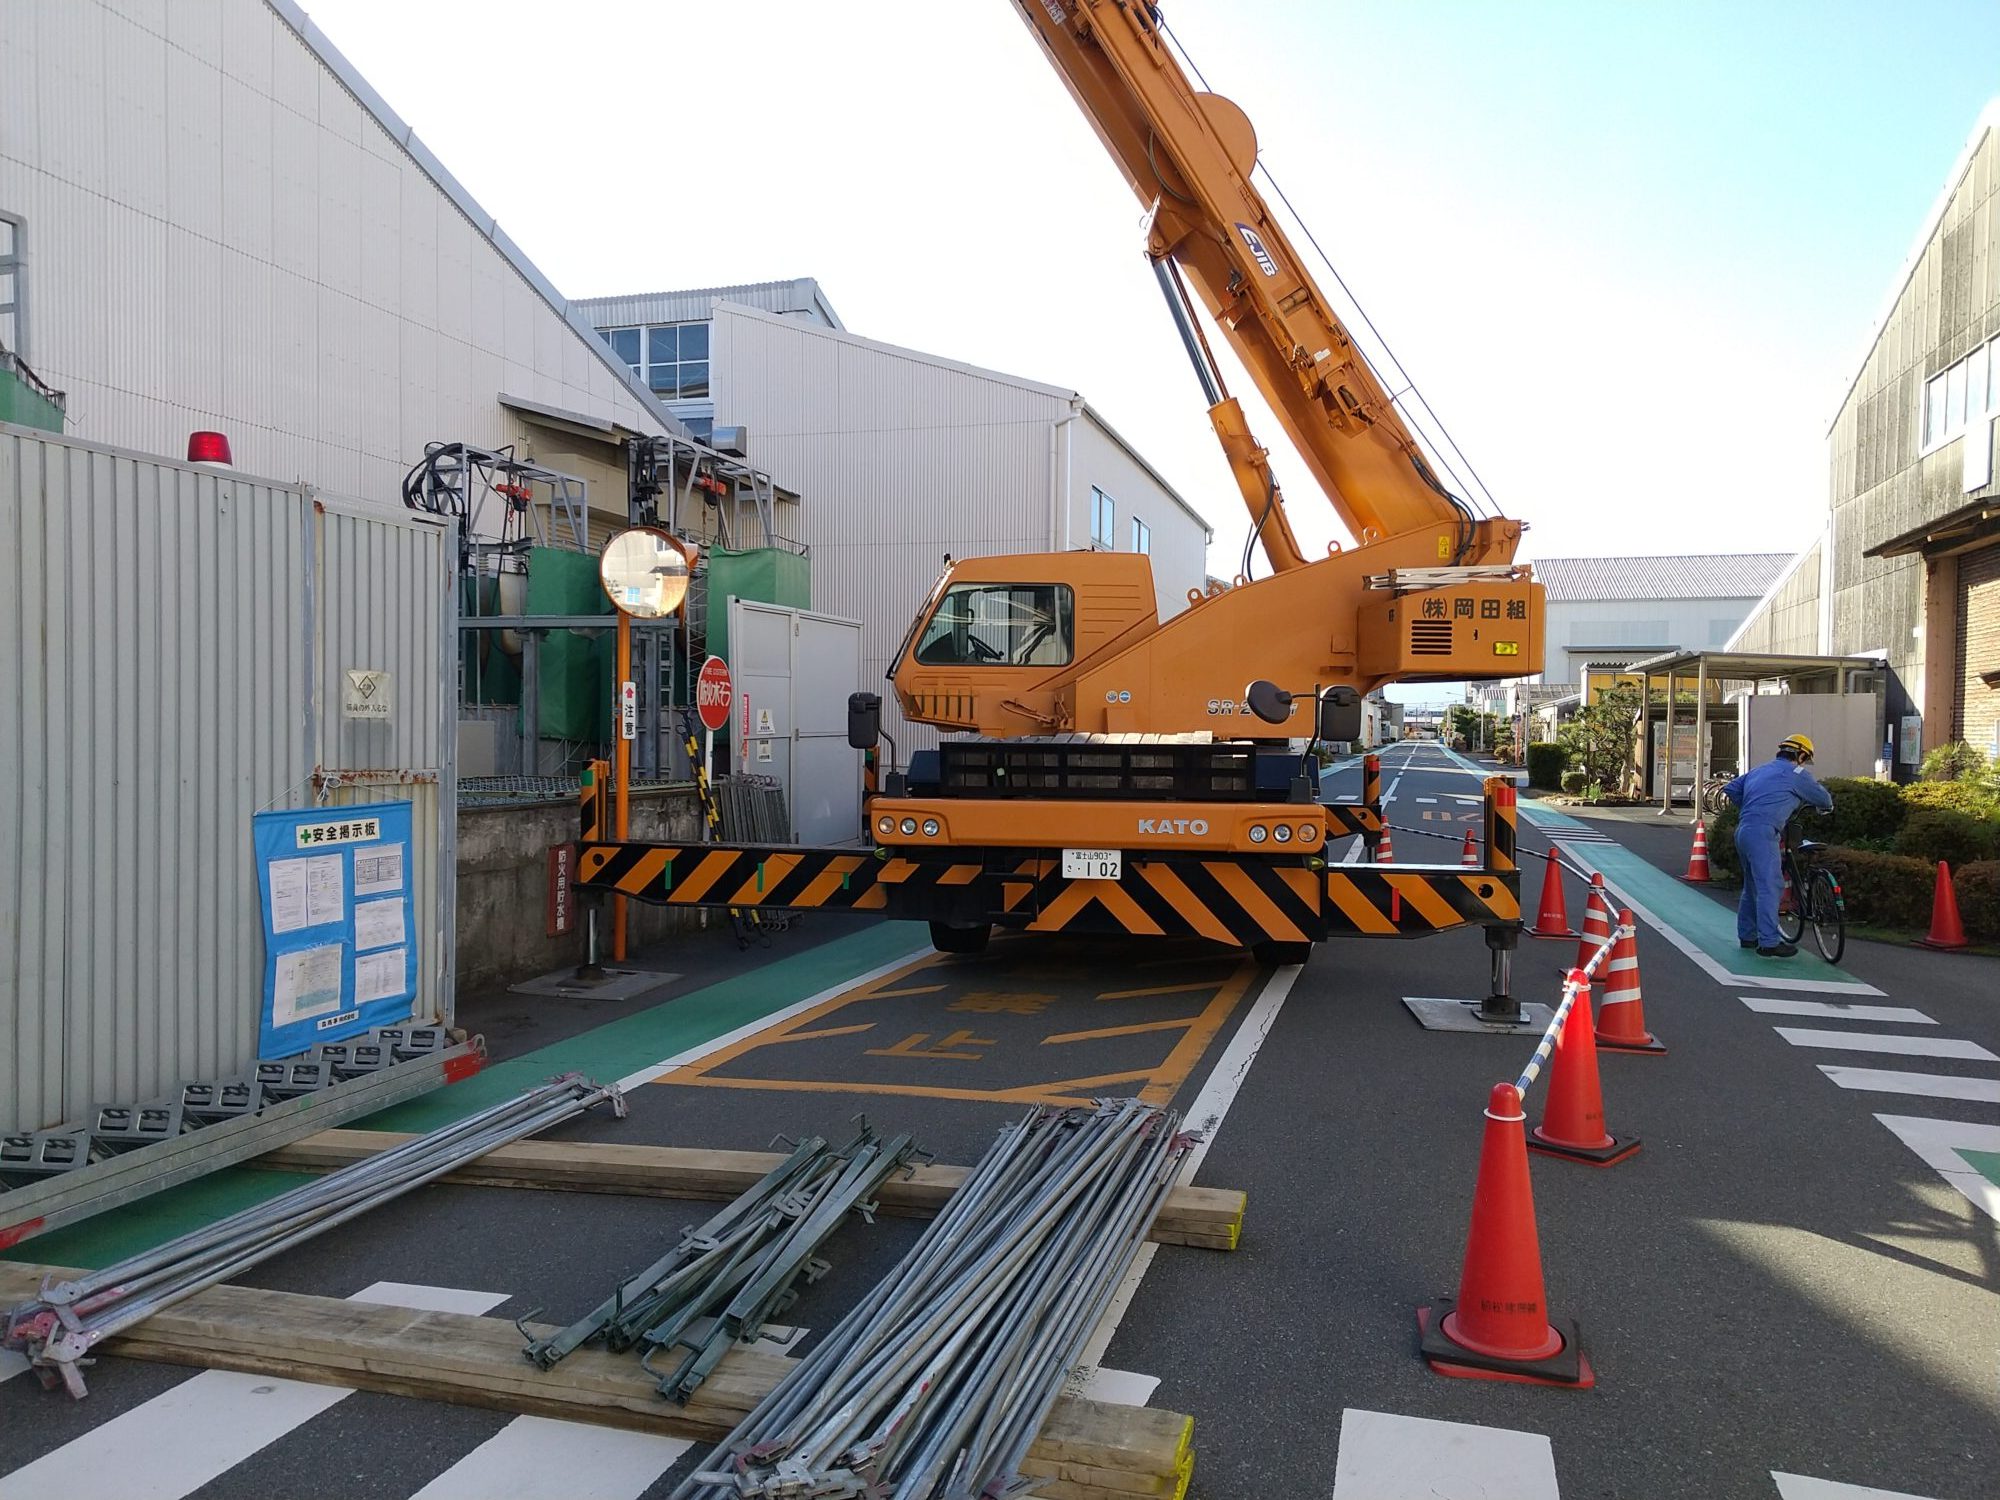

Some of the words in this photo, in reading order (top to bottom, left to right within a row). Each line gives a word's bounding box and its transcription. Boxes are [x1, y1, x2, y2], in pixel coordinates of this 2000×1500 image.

[625, 704, 634, 736] 注意
[313, 822, 376, 842] 安全掲示板
[1138, 819, 1209, 836] KATO
